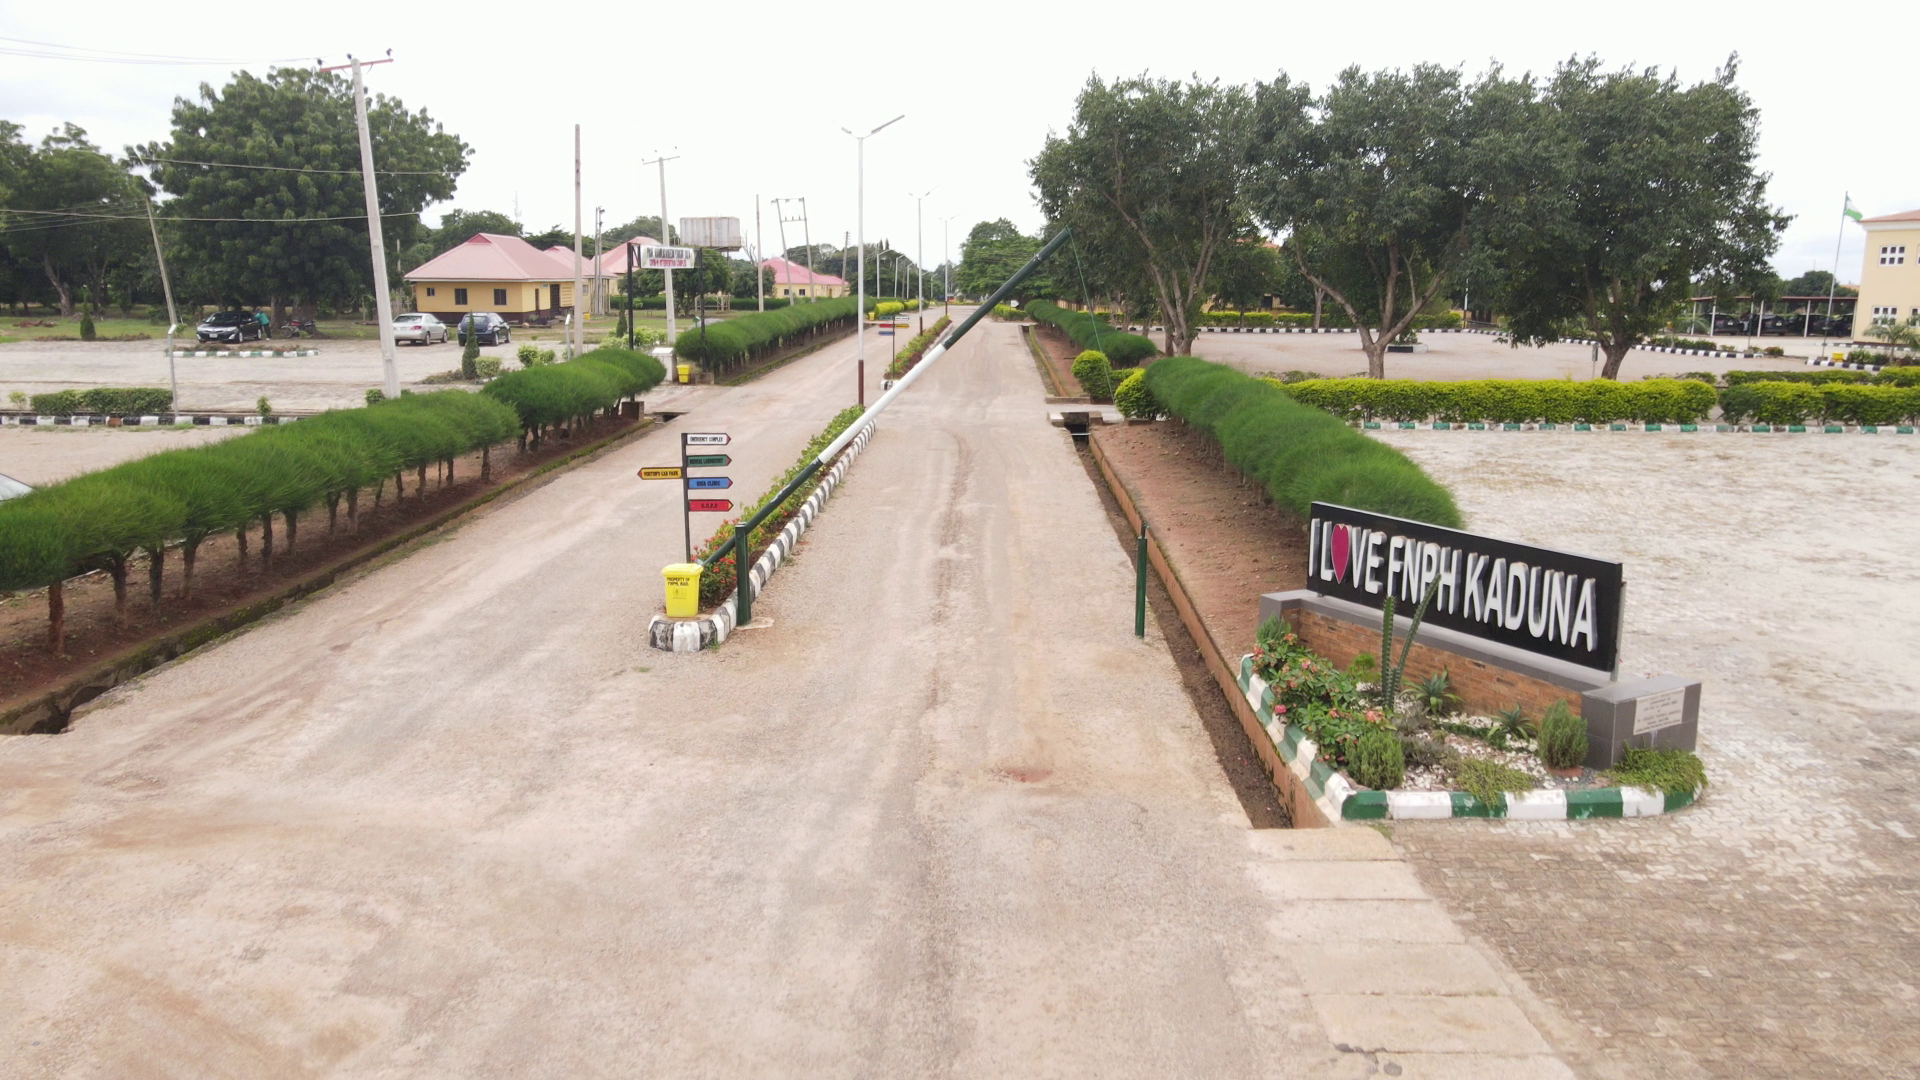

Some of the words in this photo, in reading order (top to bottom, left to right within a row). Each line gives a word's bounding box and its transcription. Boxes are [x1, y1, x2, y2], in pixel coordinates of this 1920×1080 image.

[1308, 518, 1320, 577] I
[1387, 535, 1462, 615] FNPH
[1463, 552, 1597, 652] KADUNA
